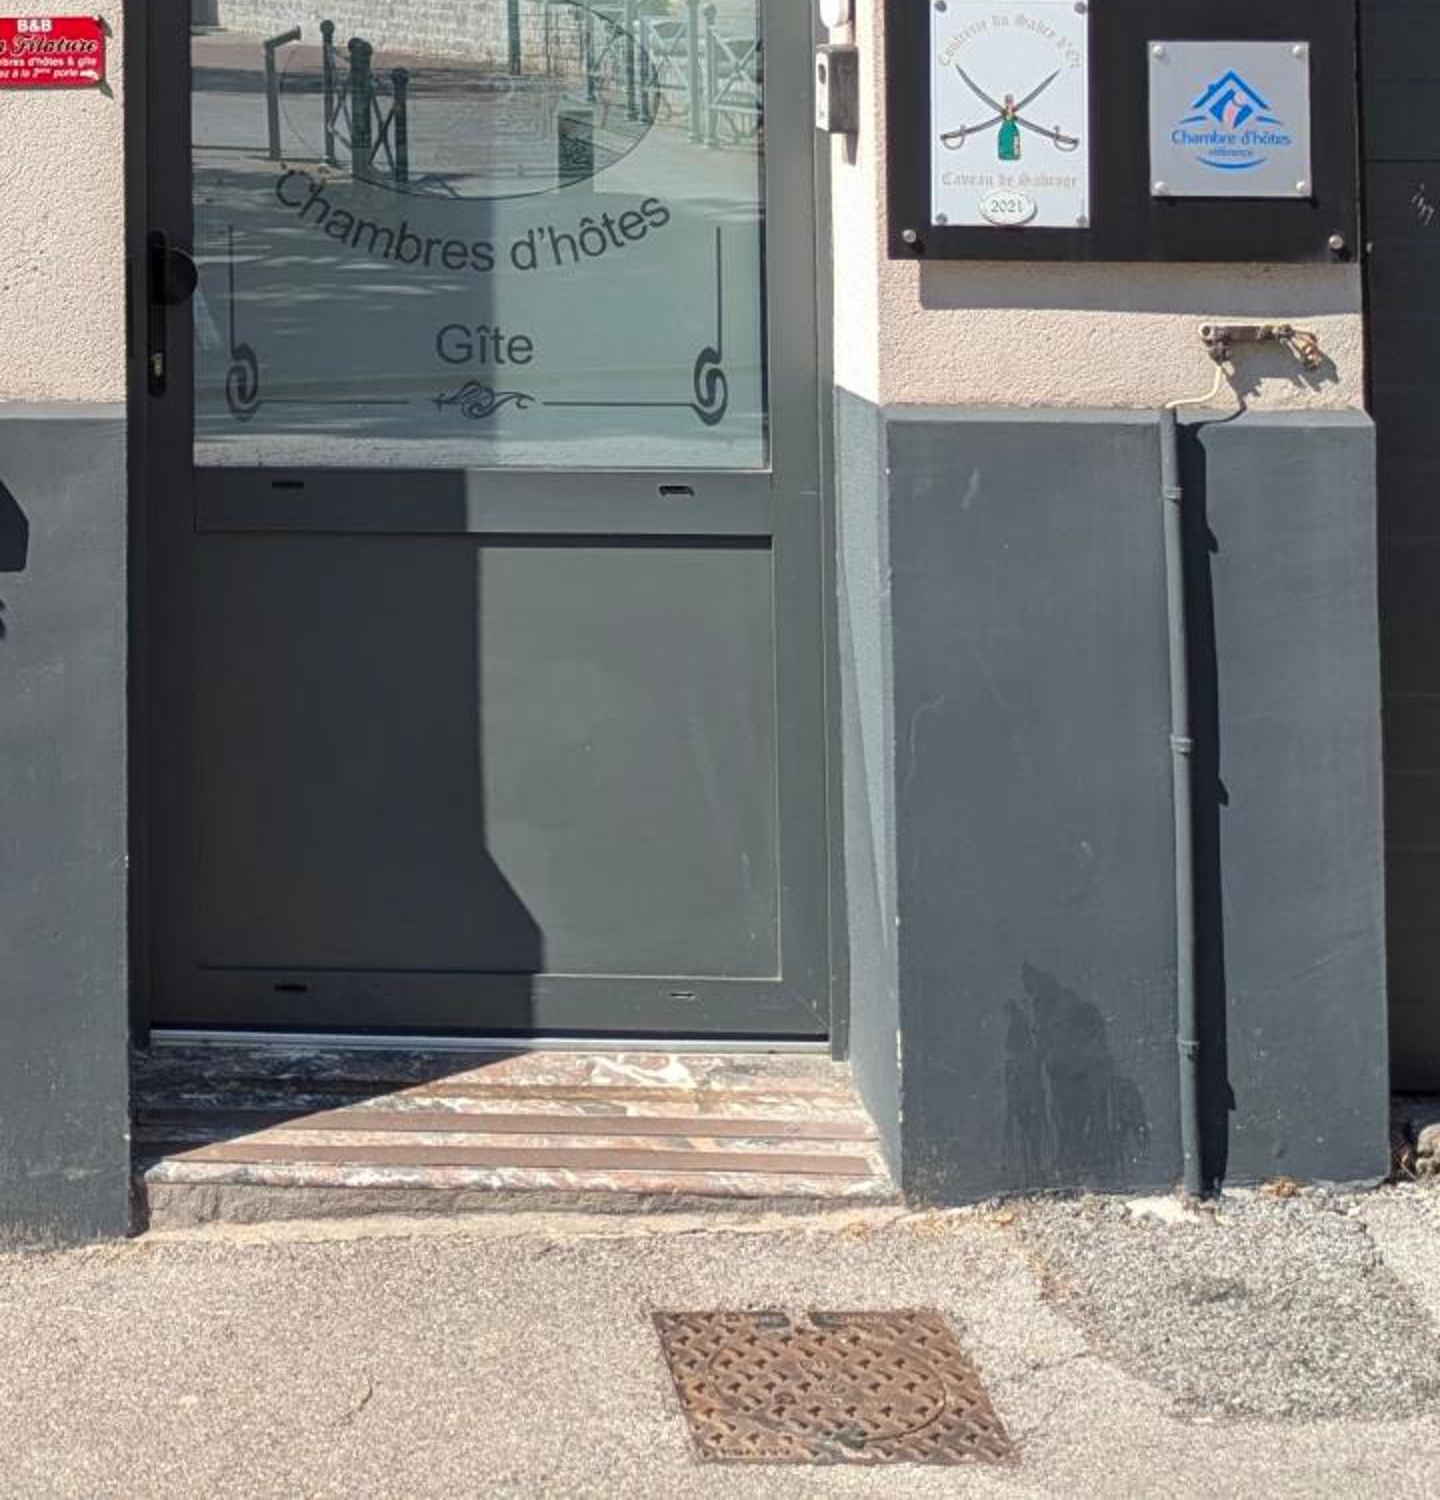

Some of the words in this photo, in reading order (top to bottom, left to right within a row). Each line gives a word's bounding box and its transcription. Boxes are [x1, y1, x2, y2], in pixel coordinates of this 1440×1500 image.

[17, 19, 52, 33] B&B
[11, 34, 98, 56] Filature
[1171, 129, 1238, 146] Chambre
[275, 168, 494, 272] Chambres
[435, 324, 534, 366] Gîte
